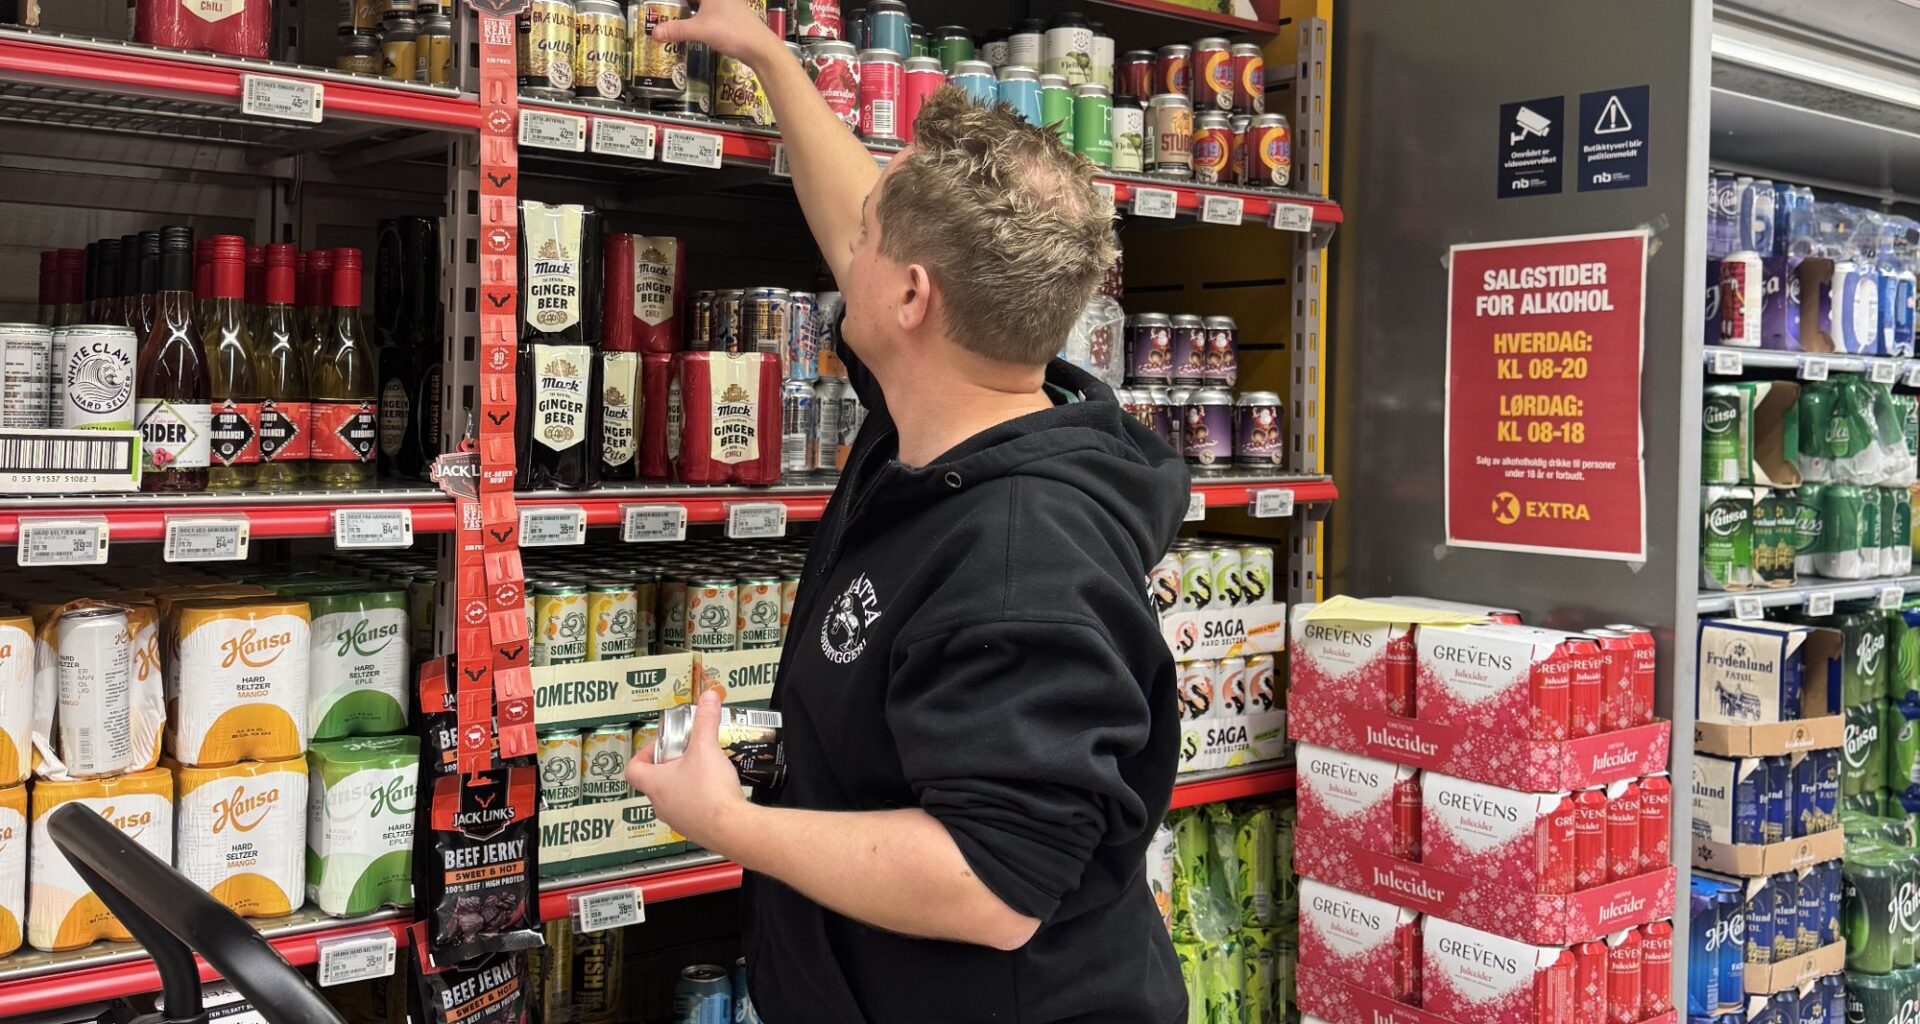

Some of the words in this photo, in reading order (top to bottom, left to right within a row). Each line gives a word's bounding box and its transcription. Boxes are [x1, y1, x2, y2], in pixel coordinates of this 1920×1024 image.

[200, 0, 223, 12] CHILI
[1583, 142, 1629, 153] Butikktyveri
[1629, 139, 1643, 148] blir
[1504, 156, 1557, 168] videoovervåket
[1511, 150, 1542, 160] Området
[1542, 149, 1550, 157] er
[1587, 150, 1638, 162] politianmeldt
[1512, 178, 1530, 190] nb
[1593, 172, 1612, 184] nb
[534, 261, 571, 276] Mack
[638, 263, 670, 277] Mack
[1483, 263, 1607, 291] SALGSTIDER
[531, 284, 576, 297] GINGER
[636, 282, 672, 295] GINGER
[537, 297, 568, 311] BEER
[641, 293, 665, 305] BEER
[1476, 295, 1514, 317] FOR
[1520, 289, 1614, 315] ALKOHOL
[1493, 331, 1593, 354] HVERDAG:
[67, 346, 91, 389] WHITE
[92, 342, 132, 366] CLAW
[1498, 360, 1523, 379] KL
[1528, 358, 1588, 379] 08-20
[541, 376, 580, 392] Mack
[75, 393, 103, 411] HARD
[106, 375, 131, 410] SELTZER
[538, 399, 584, 414] GINGER
[717, 405, 752, 417] Mack
[1499, 395, 1584, 417] LØRDAG:
[219, 413, 238, 423] SIDER
[544, 411, 575, 426] BEER
[142, 422, 187, 443] SIDER
[604, 426, 632, 437] NGER
[714, 425, 756, 438] GINGER
[1498, 421, 1522, 442] KL
[1527, 422, 1585, 443] 08-18
[720, 436, 749, 448] BEER
[1476, 455, 1491, 467] Salg
[1492, 457, 1501, 466] av
[1501, 457, 1548, 468] alkoholholdig
[1549, 458, 1572, 468] drikke
[1572, 458, 1581, 468] til
[1582, 459, 1617, 470] personer
[435, 464, 470, 478] JACK
[1504, 469, 1525, 478] under
[1526, 469, 1536, 479] 18
[1536, 469, 1546, 479] år
[1545, 471, 1555, 479] er
[1555, 470, 1585, 481] forbudt.
[11, 475, 18, 484] 0
[21, 475, 32, 484] 53
[36, 475, 61, 484] 91537
[64, 475, 90, 484] 51082
[91, 475, 97, 484] 3
[1525, 501, 1591, 521] EXTRA
[1204, 618, 1245, 639] SAGA
[337, 618, 399, 658] Hansa
[1304, 624, 1373, 649] GREVENS
[221, 627, 293, 669] Hansa
[551, 642, 587, 656] SOMERS
[1433, 644, 1512, 671] GREVENS
[1706, 651, 1774, 674] Frydenlund
[349, 670, 381, 679] SELTZER
[354, 664, 375, 672] HARD
[1454, 668, 1489, 682] Julecider
[242, 676, 266, 684] HARD
[354, 678, 374, 686] EPLE
[634, 671, 658, 685] LITE
[236, 682, 272, 691] SELTZER
[532, 680, 619, 708] OMERSBY
[237, 690, 269, 699] MANGO
[1206, 725, 1248, 746] SAGA
[1366, 725, 1439, 756] Julecider
[1592, 747, 1639, 774] Julecider
[1310, 759, 1379, 788] GREVENS
[211, 785, 280, 835] Hansa
[631, 806, 655, 821] LITE
[1438, 790, 1518, 822] GREVENS
[453, 812, 481, 827] JACK
[1459, 816, 1495, 832] Julecider
[388, 823, 412, 833] HARD
[539, 819, 615, 847] MERSBY
[231, 843, 253, 852] HARD
[388, 838, 410, 847] EPLE
[226, 850, 259, 861] SELTZER
[445, 846, 481, 869] BEEF
[482, 840, 525, 864] JERKY
[227, 859, 257, 869] MANGO
[456, 869, 487, 881] SWEET
[499, 864, 518, 874] HOT
[445, 884, 465, 894] 100%
[465, 882, 481, 892] BEEF
[485, 879, 502, 889] HIGH
[502, 874, 525, 886] PROTEIN
[1373, 866, 1446, 903] Julecider
[1312, 896, 1381, 931] GREVENS
[1598, 895, 1646, 926] Julecider
[1438, 937, 1518, 975] GREVENS
[1458, 964, 1494, 983] Julecider
[441, 976, 477, 1011] BEEF
[478, 955, 519, 993] JERKY
[455, 996, 485, 1018] SWEET
[497, 983, 513, 999] HOT
